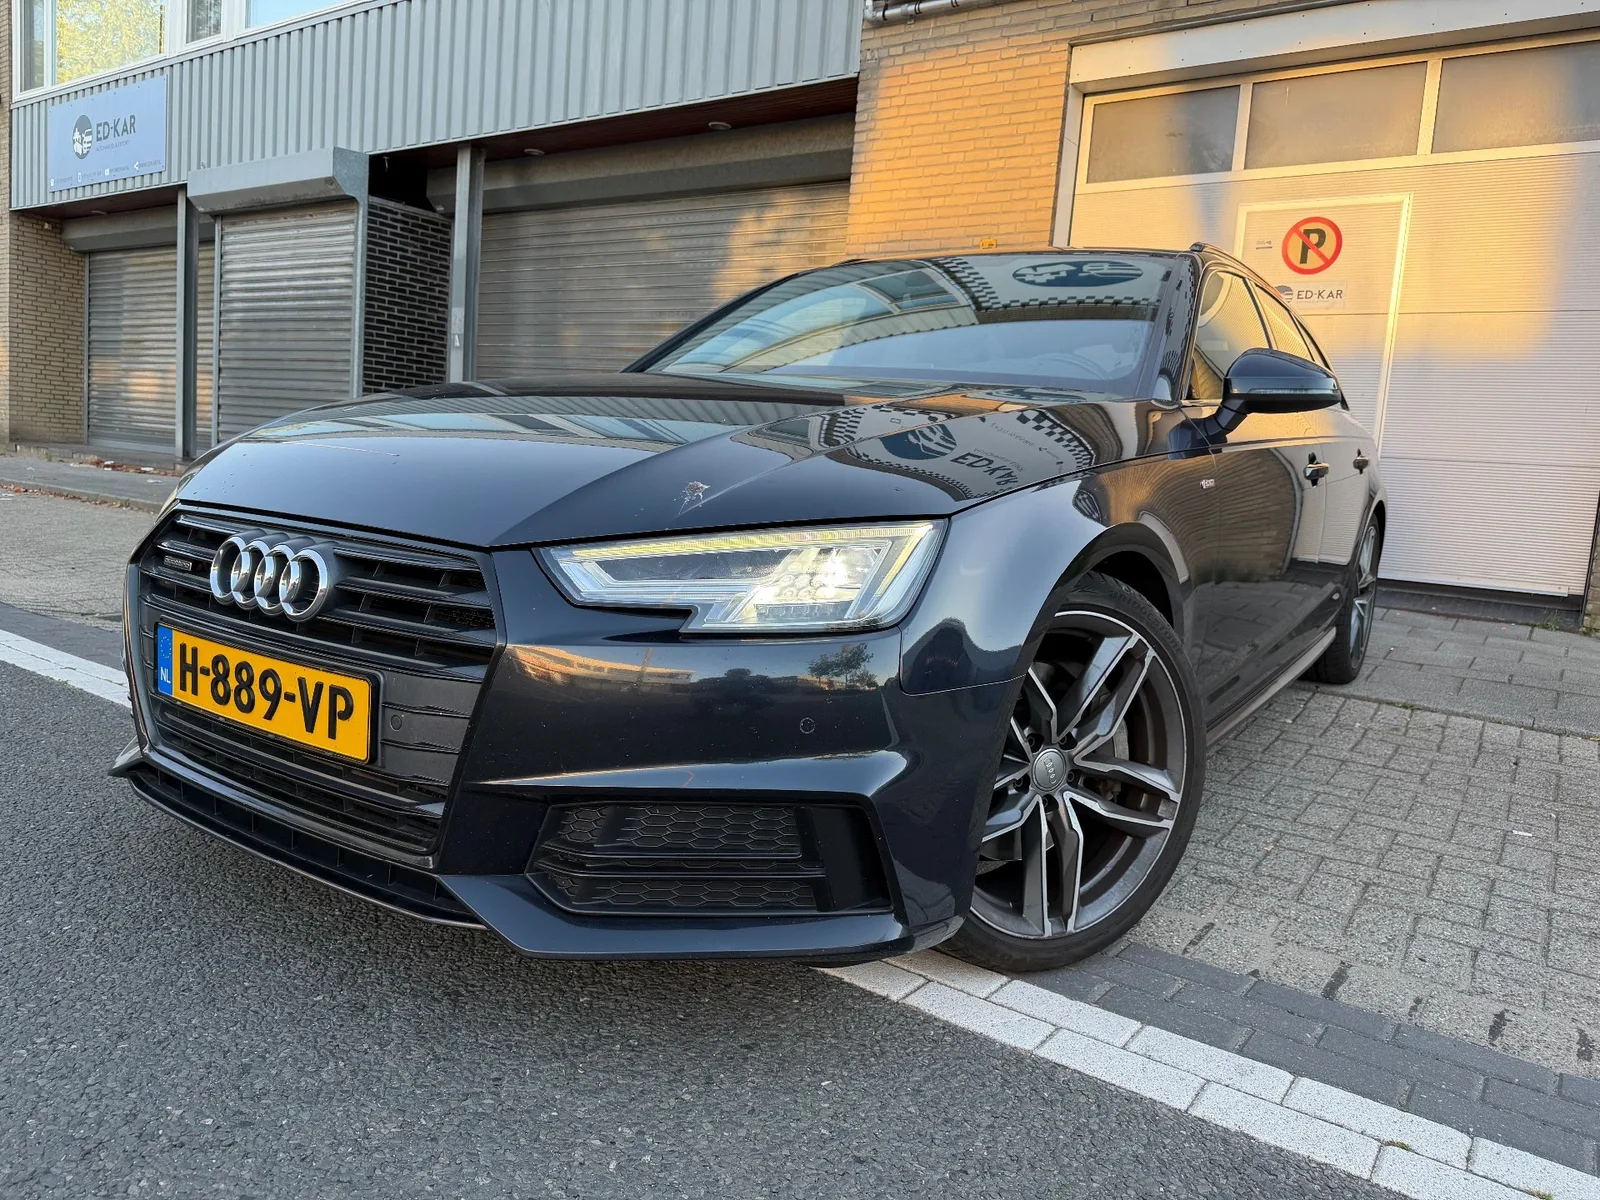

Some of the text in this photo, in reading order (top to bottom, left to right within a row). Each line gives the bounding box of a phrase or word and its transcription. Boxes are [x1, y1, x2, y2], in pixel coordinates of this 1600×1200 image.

[1299, 228, 1327, 265] P
[160, 666, 171, 684] NL
[179, 642, 354, 740] H-889-VP
